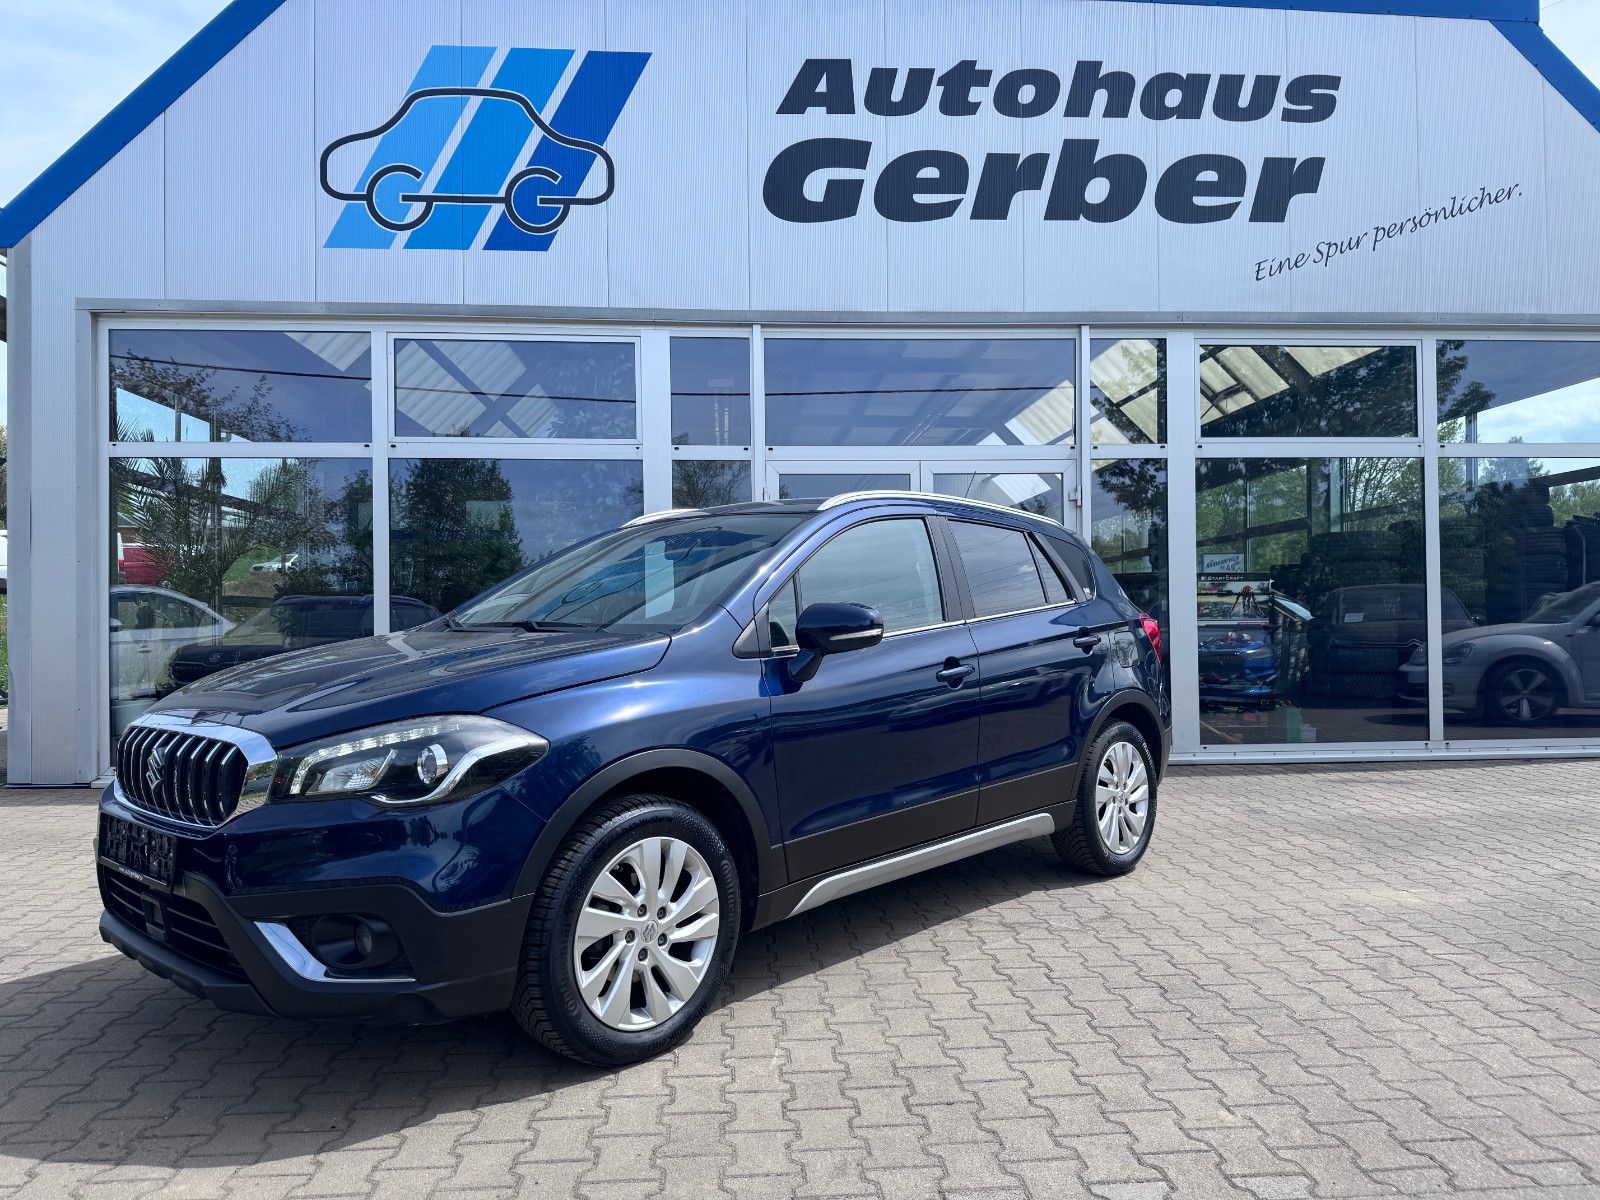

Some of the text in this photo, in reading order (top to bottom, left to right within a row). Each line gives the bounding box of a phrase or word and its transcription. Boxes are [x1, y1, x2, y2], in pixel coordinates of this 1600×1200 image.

[776, 59, 1341, 123] Autohaus
[763, 138, 1326, 224] Gerber
[1254, 182, 1523, 281] Eine Spur persönlicher.
